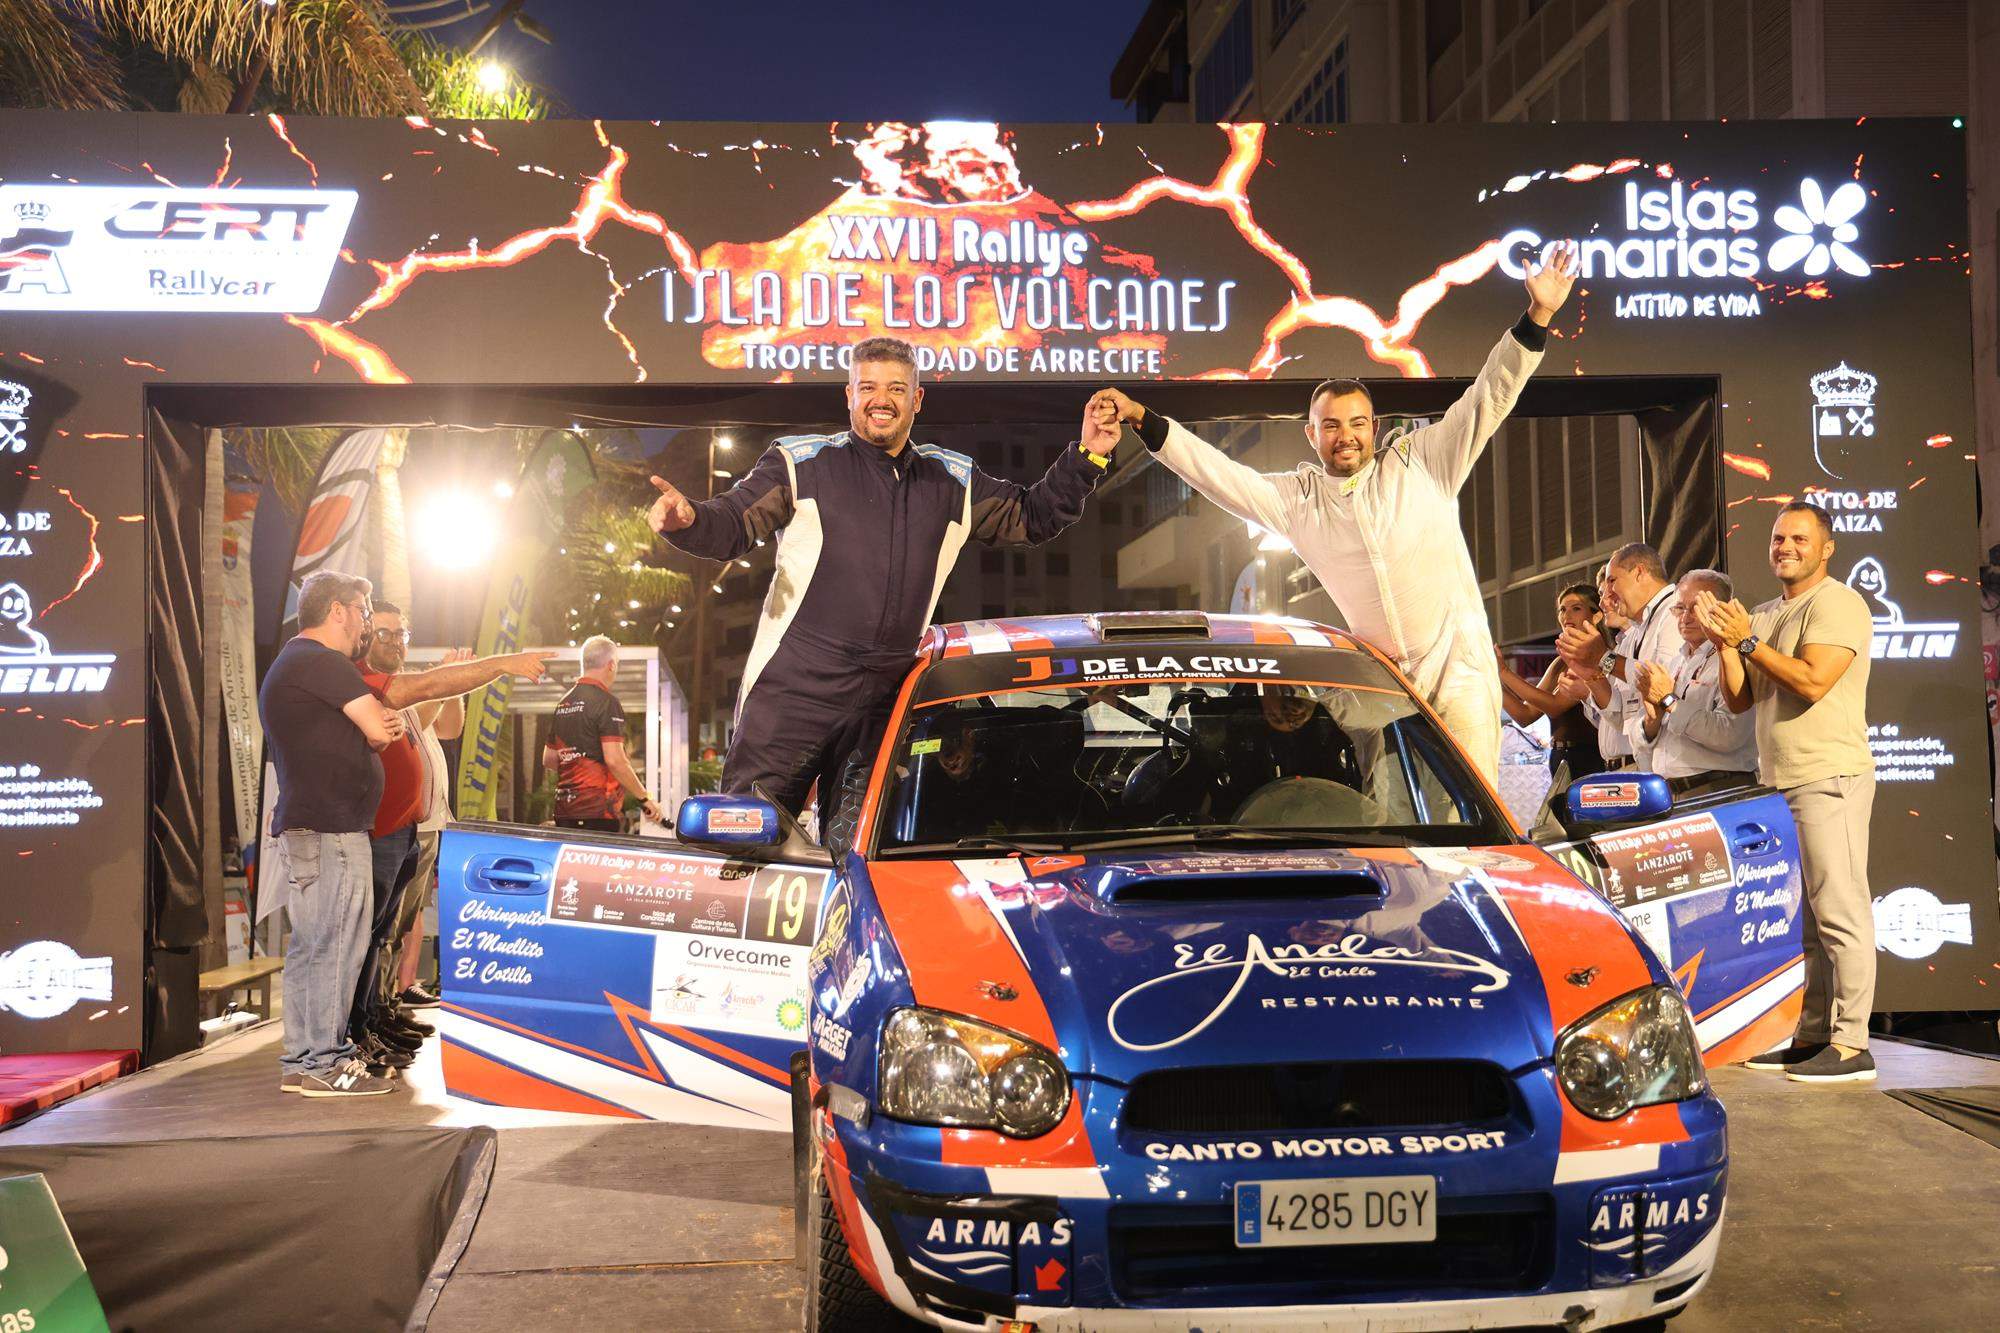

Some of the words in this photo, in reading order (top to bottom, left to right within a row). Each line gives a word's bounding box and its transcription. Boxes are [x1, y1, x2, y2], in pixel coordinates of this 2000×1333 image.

[1624, 181, 1760, 231] Islas
[104, 200, 330, 241] CERT
[828, 215, 938, 261] XXVII
[953, 219, 1088, 277] Rallye
[1498, 228, 1761, 279] Canarias
[149, 268, 276, 296] Rallycar
[664, 269, 783, 325] ISLA
[802, 271, 866, 327] DE
[884, 274, 975, 328] LOS
[993, 277, 1236, 332] VOLCANES
[1615, 293, 1689, 319] LATITUD
[1693, 295, 1716, 317] DE
[1718, 293, 1761, 318] VIDA
[917, 347, 977, 371] DAD
[985, 348, 1019, 373] DE
[1030, 348, 1161, 374] ARRECIFE
[1868, 491, 1897, 509] DE
[17, 513, 51, 531] DE
[1831, 515, 1883, 532] AIZA
[1083, 658, 1129, 675] DE
[1137, 656, 1184, 673] LA
[1190, 656, 1281, 675] CRUZ
[1083, 674, 1121, 682] TALLER
[0, 667, 112, 692] ELIN
[0, 778, 94, 795] cuperación,
[562, 851, 600, 866] XXVII
[660, 861, 676, 873] de
[1636, 849, 1694, 872] LANZAROTE
[1735, 860, 1789, 888] Chiringuito
[606, 882, 694, 901] LANZAROTE
[1735, 891, 1749, 915] El
[459, 900, 547, 929] Chiringuito
[764, 873, 808, 940] 19
[452, 928, 475, 949] El
[477, 931, 544, 957] Muellito
[1741, 921, 1755, 945] El
[1757, 918, 1790, 943] Cotillo
[688, 939, 791, 968] Orvecame
[1174, 943, 1233, 970] El
[455, 957, 477, 978] El
[481, 961, 533, 984] Cotillo
[1289, 966, 1311, 978] El
[1318, 965, 1377, 978] Cotillo
[1261, 996, 1485, 1010] RESTAURANTE
[813, 1012, 852, 1050] TARGET
[1145, 1142, 1262, 1161] CANTO
[1272, 1137, 1393, 1158] MOTOR
[1399, 1131, 1506, 1154] SPORT
[1603, 1191, 1657, 1202] NAVIRA
[1266, 1192, 1353, 1232] 4285
[1364, 1190, 1430, 1228] DGY
[1590, 1193, 1710, 1232] ARMAS
[926, 1217, 1073, 1247] ARMAS
[1242, 1220, 1256, 1234] E
[0, 1308, 36, 1333] as
